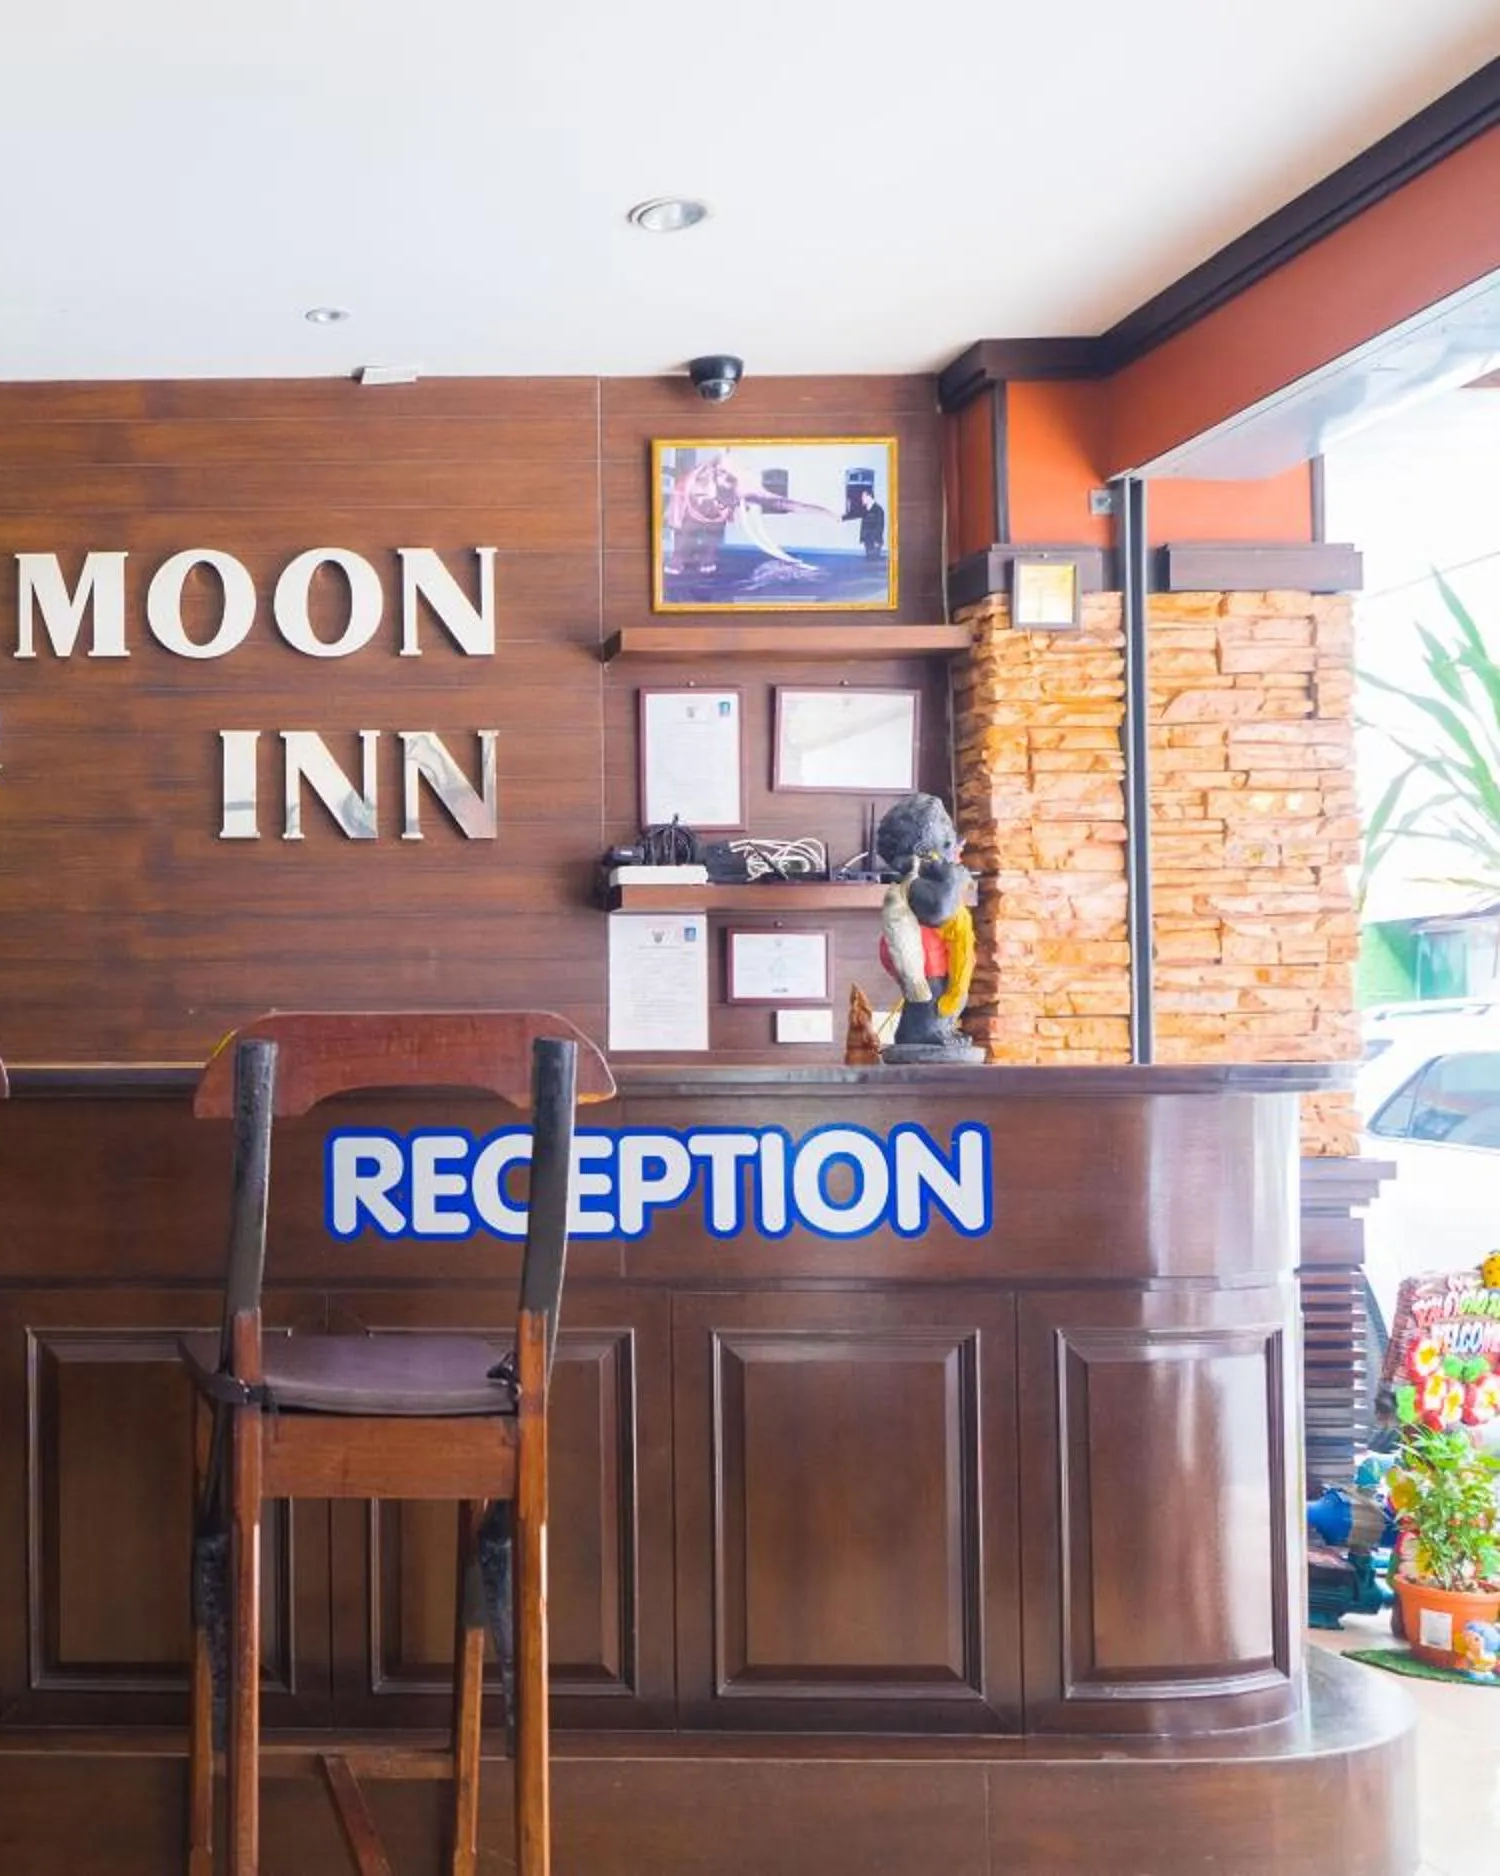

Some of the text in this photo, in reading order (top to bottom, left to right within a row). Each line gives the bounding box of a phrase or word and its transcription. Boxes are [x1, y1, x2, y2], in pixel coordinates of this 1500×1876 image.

[13, 546, 498, 659] MOON
[219, 730, 499, 840] INN
[328, 1123, 993, 1240] RECEPTION
